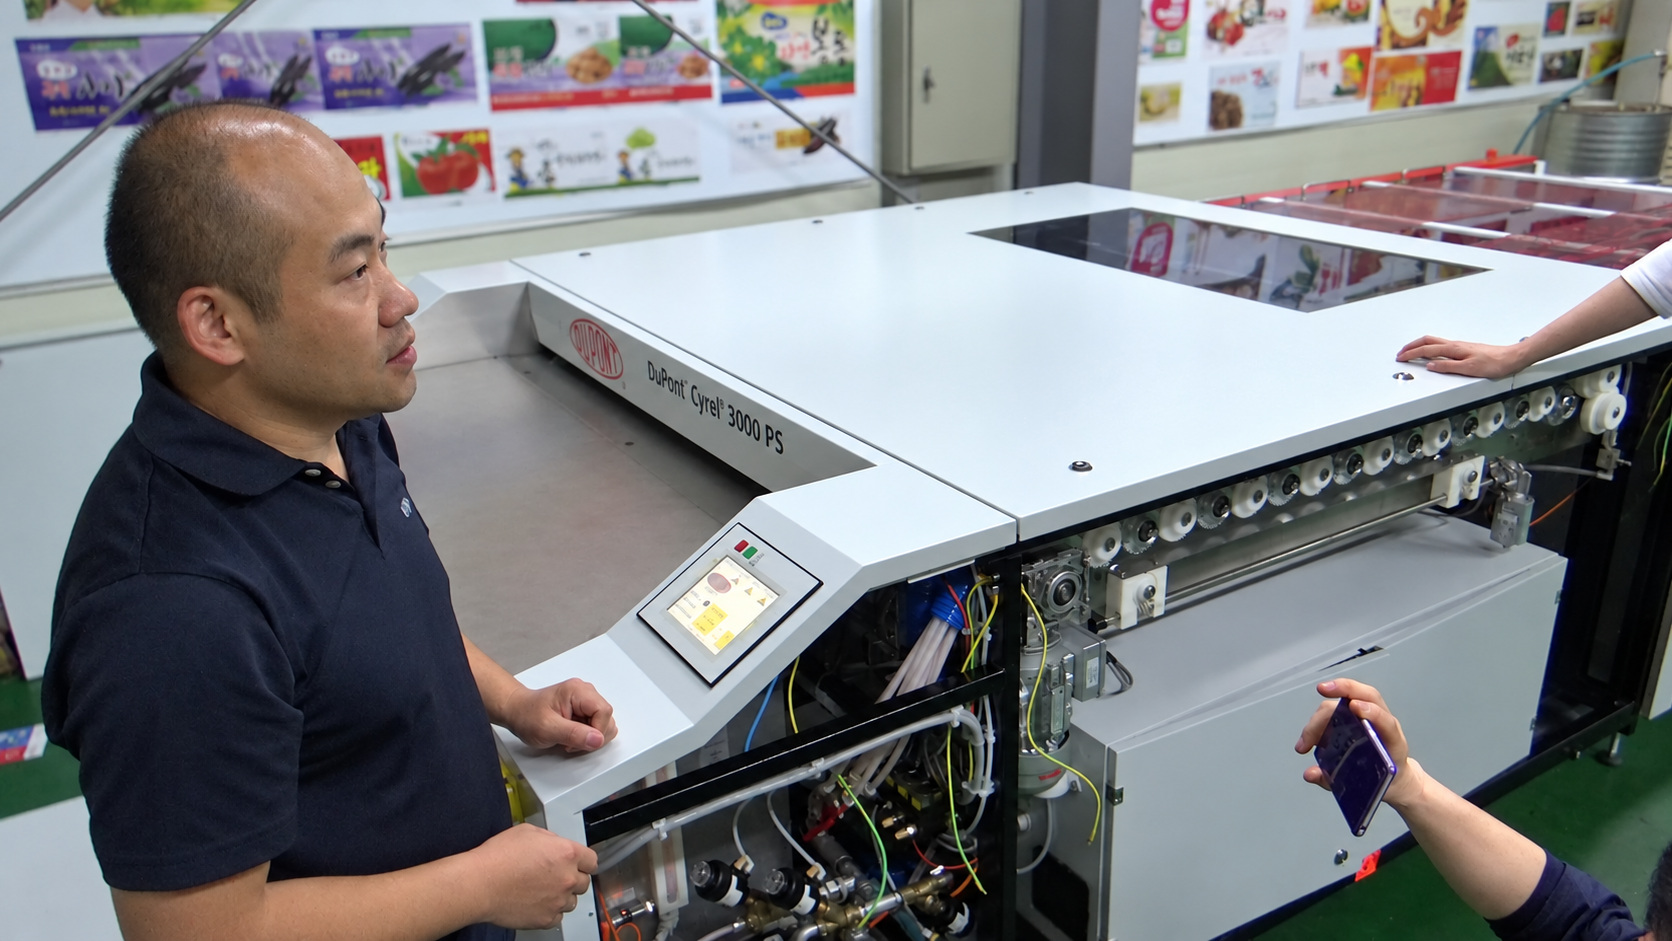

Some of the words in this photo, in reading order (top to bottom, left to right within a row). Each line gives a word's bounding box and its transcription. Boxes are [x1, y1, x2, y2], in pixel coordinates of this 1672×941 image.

[574, 323, 618, 375] DUPONT
[727, 404, 761, 441] 3000
[765, 424, 784, 455] PS
